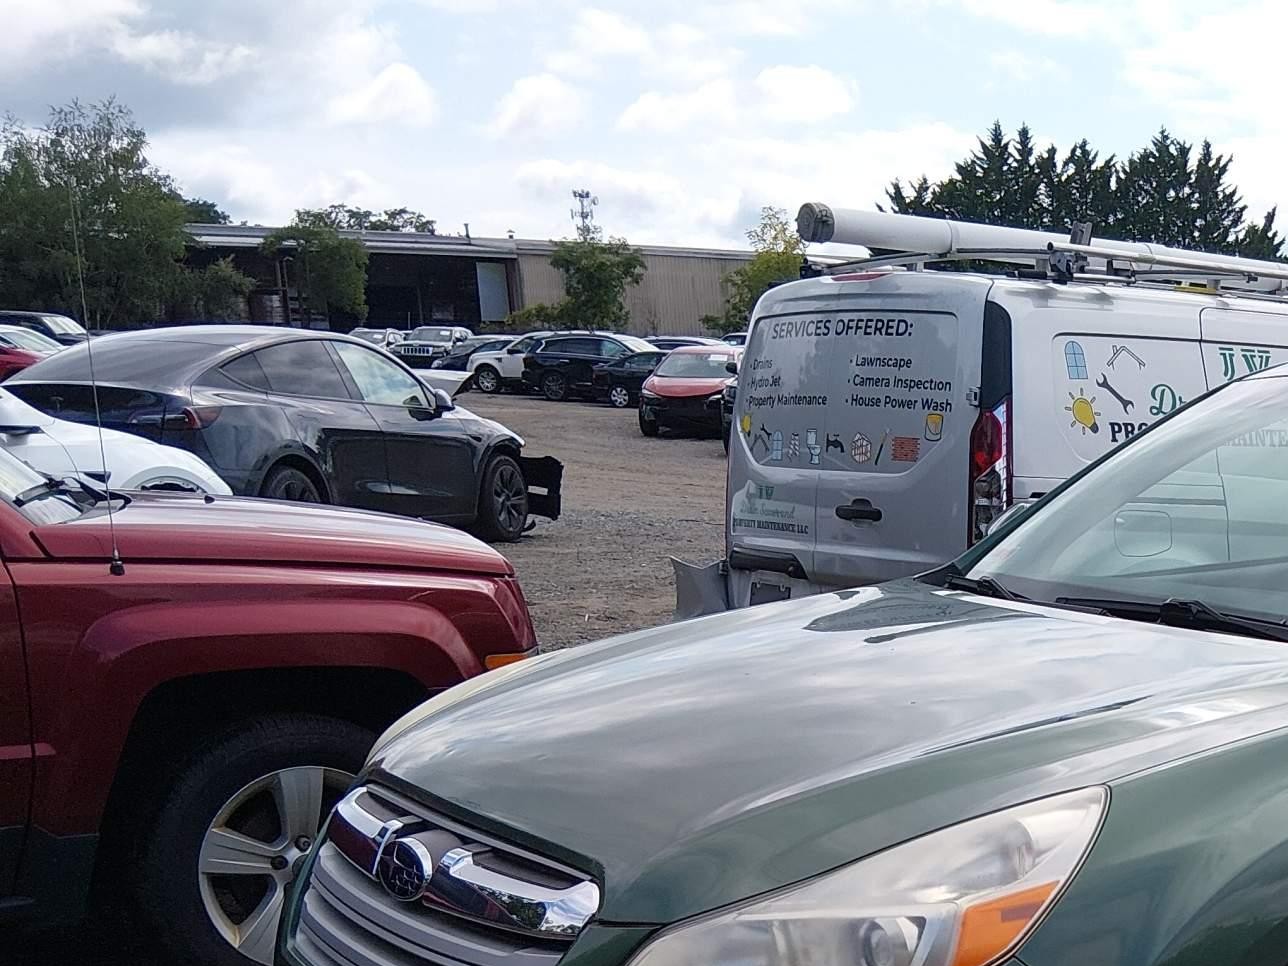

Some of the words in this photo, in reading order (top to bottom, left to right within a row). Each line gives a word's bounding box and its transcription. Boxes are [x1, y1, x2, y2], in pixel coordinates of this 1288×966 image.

[772, 319, 831, 339] SERVICES
[834, 318, 914, 337] OFFERED:
[752, 359, 773, 370] Drains
[855, 354, 913, 371] Lawnscape
[750, 375, 769, 391] Hydro
[769, 375, 781, 388] Jet
[852, 374, 891, 388] Camera
[893, 376, 952, 392] Inspection
[748, 394, 776, 408] Property
[777, 392, 828, 406] Maintenance
[850, 393, 882, 407] House
[884, 395, 918, 410] Power
[921, 397, 953, 413] Wash
[796, 524, 809, 535] LLC
